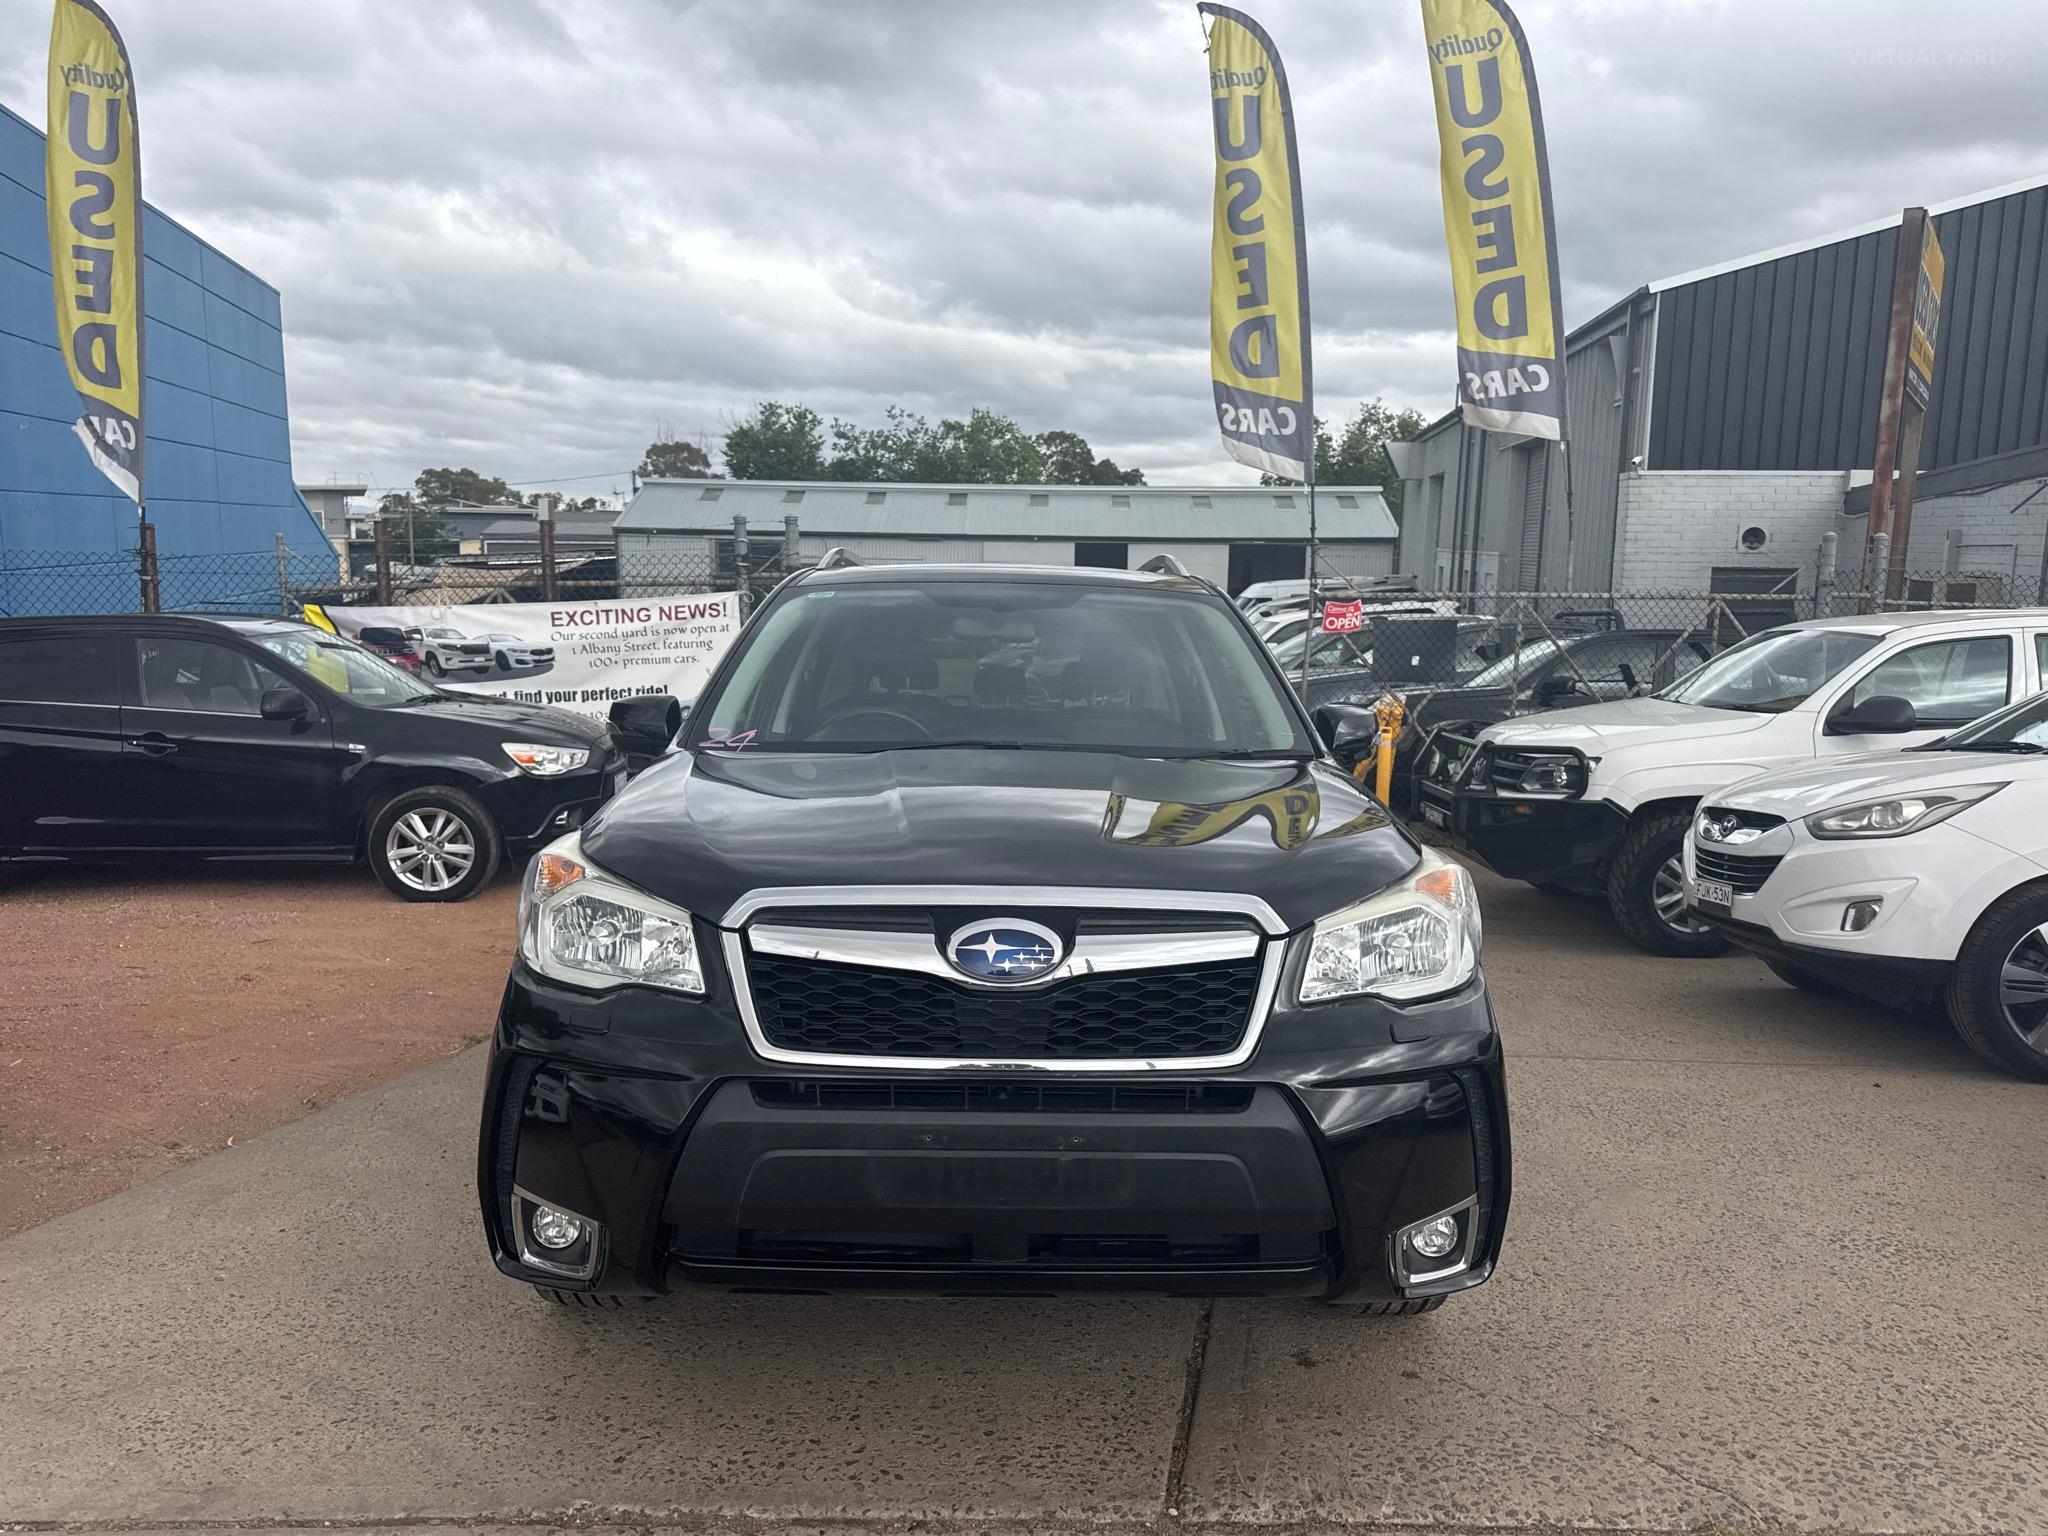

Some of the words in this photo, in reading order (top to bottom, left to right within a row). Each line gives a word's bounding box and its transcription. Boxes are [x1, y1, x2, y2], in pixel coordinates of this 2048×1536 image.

[551, 607, 651, 627] EXCITING
[659, 602, 728, 621] NEWS!
[1325, 617, 1360, 629] OPEN
[550, 631, 576, 641] Our
[579, 628, 618, 640] second
[622, 627, 648, 642] yard
[651, 625, 661, 636] is
[663, 625, 688, 636] now
[691, 625, 717, 638] open
[719, 624, 730, 633] at
[580, 643, 621, 657] Albany
[663, 638, 714, 651] featuring
[589, 657, 618, 668] 100+
[623, 655, 671, 669] premium
[674, 655, 700, 664] cars.
[514, 689, 542, 702] find
[546, 688, 578, 704] your
[581, 686, 632, 703] perfect
